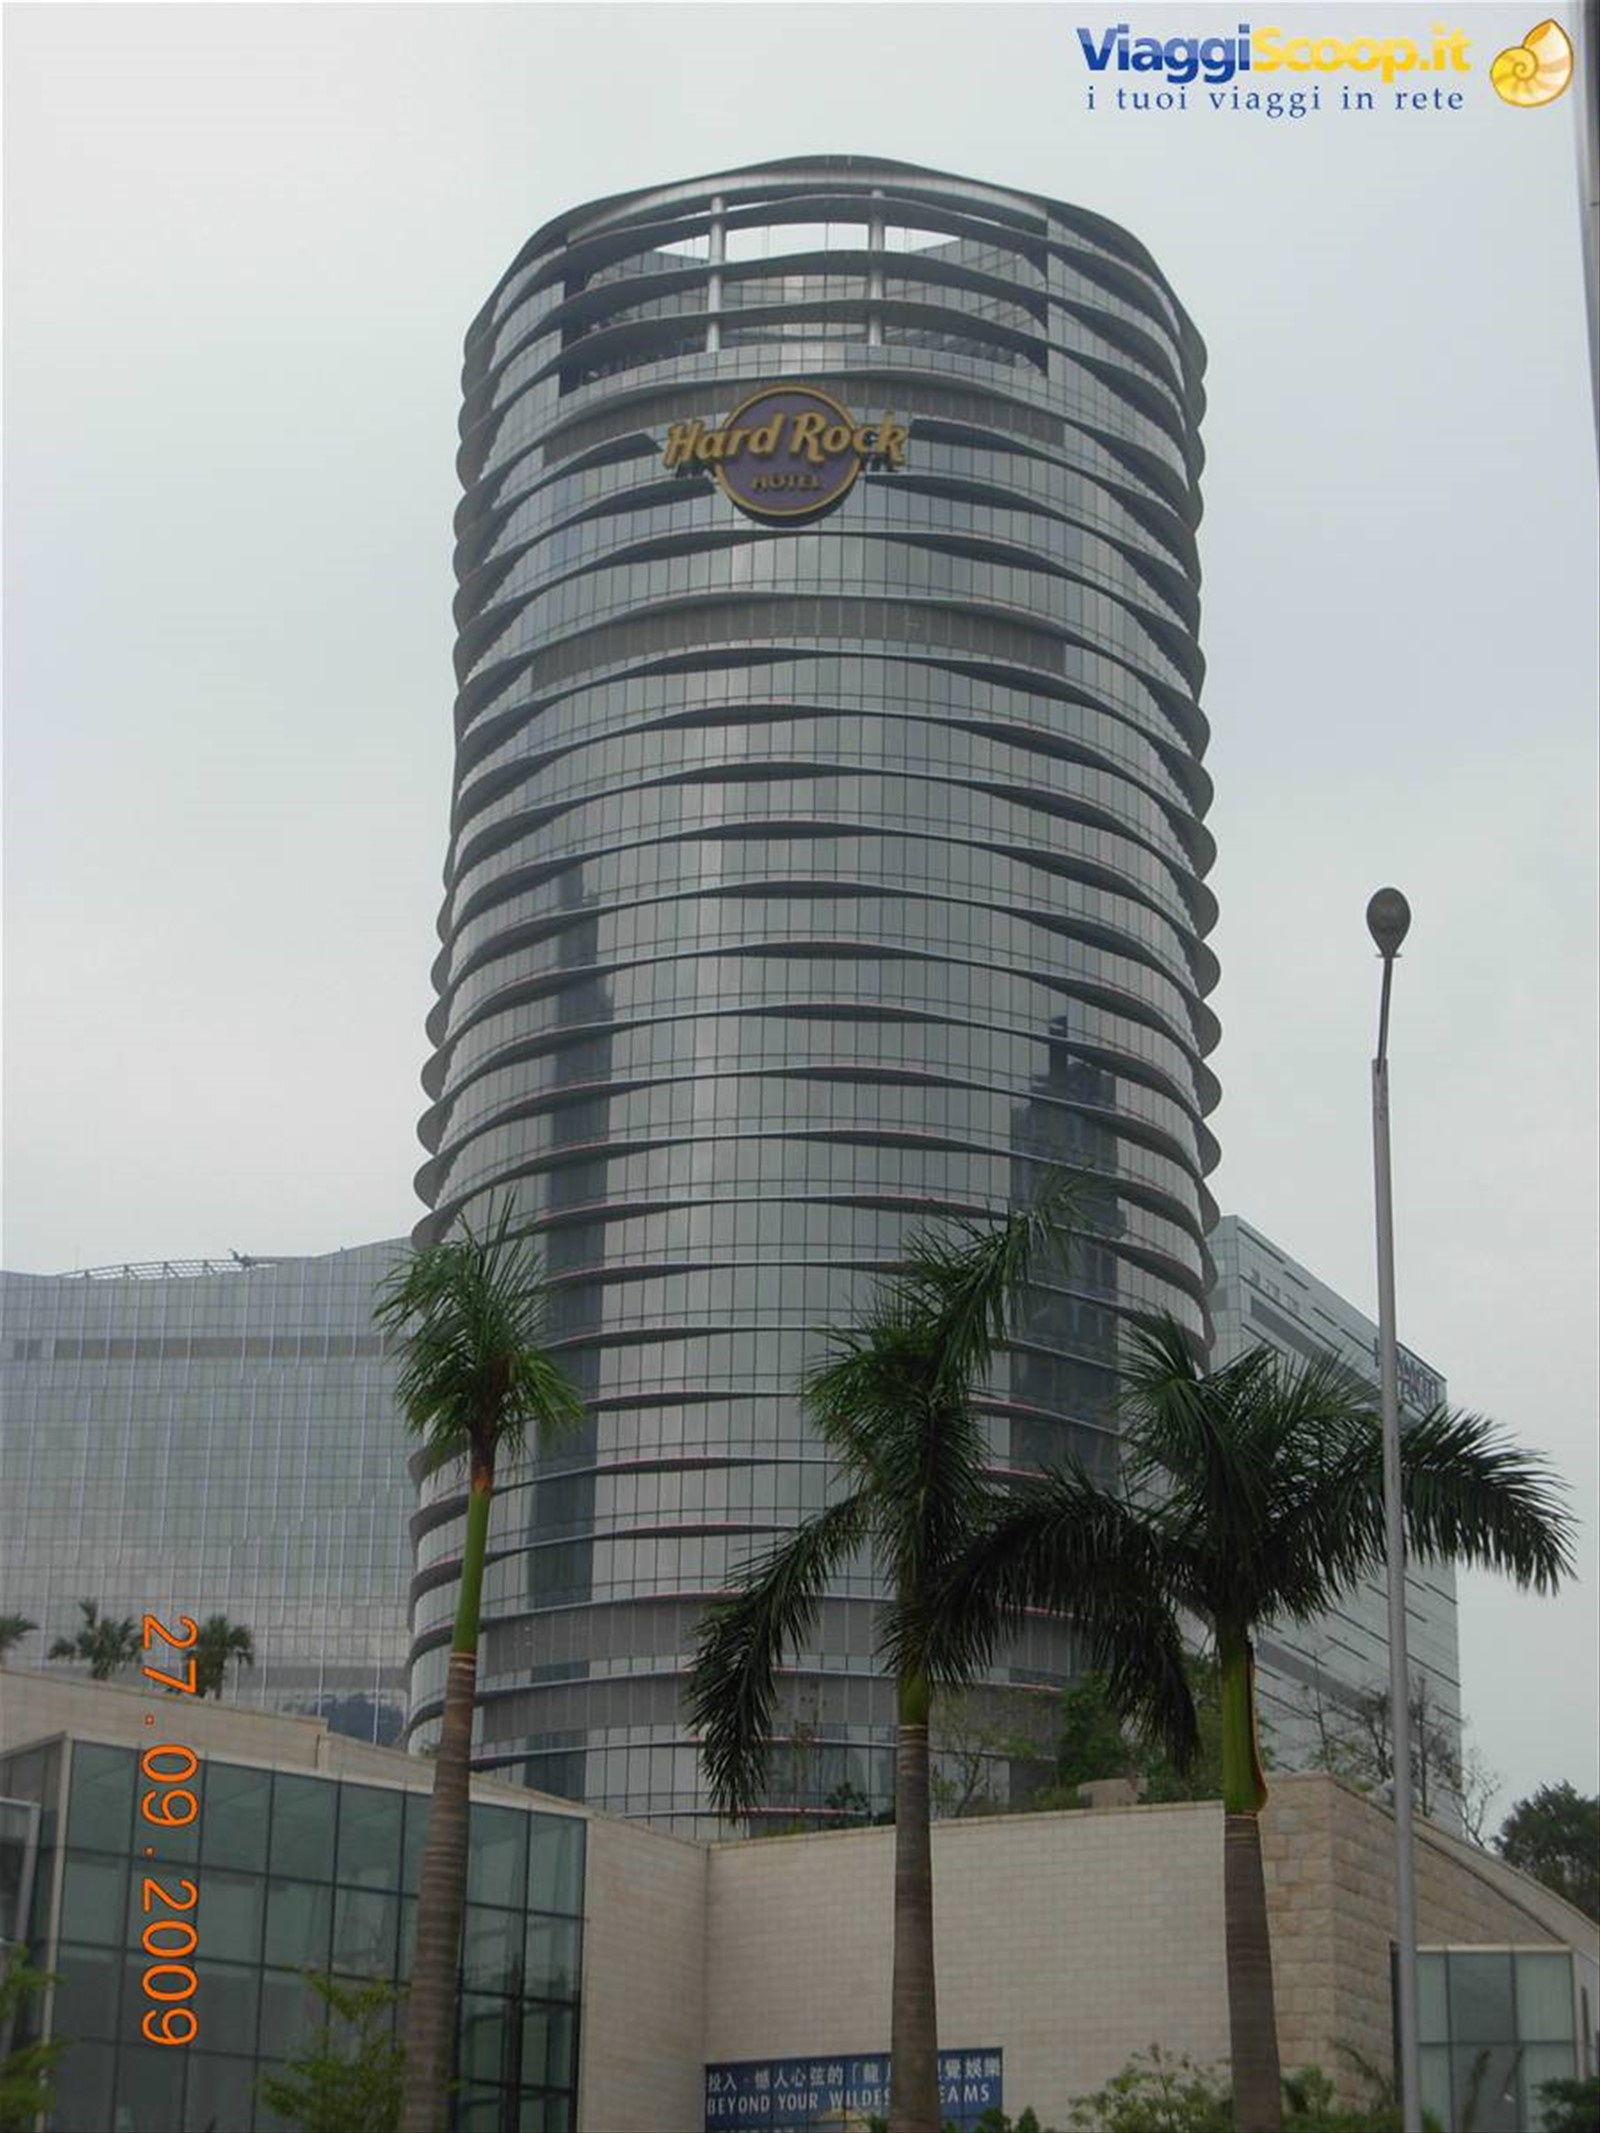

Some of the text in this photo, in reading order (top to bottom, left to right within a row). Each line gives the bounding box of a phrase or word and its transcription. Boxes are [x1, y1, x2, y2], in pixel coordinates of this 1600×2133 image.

[662, 408, 909, 469] Hard Rock
[750, 473, 821, 491] HOTEL
[707, 2083, 990, 2116] BEYOND YOUR WILDES EAMS
